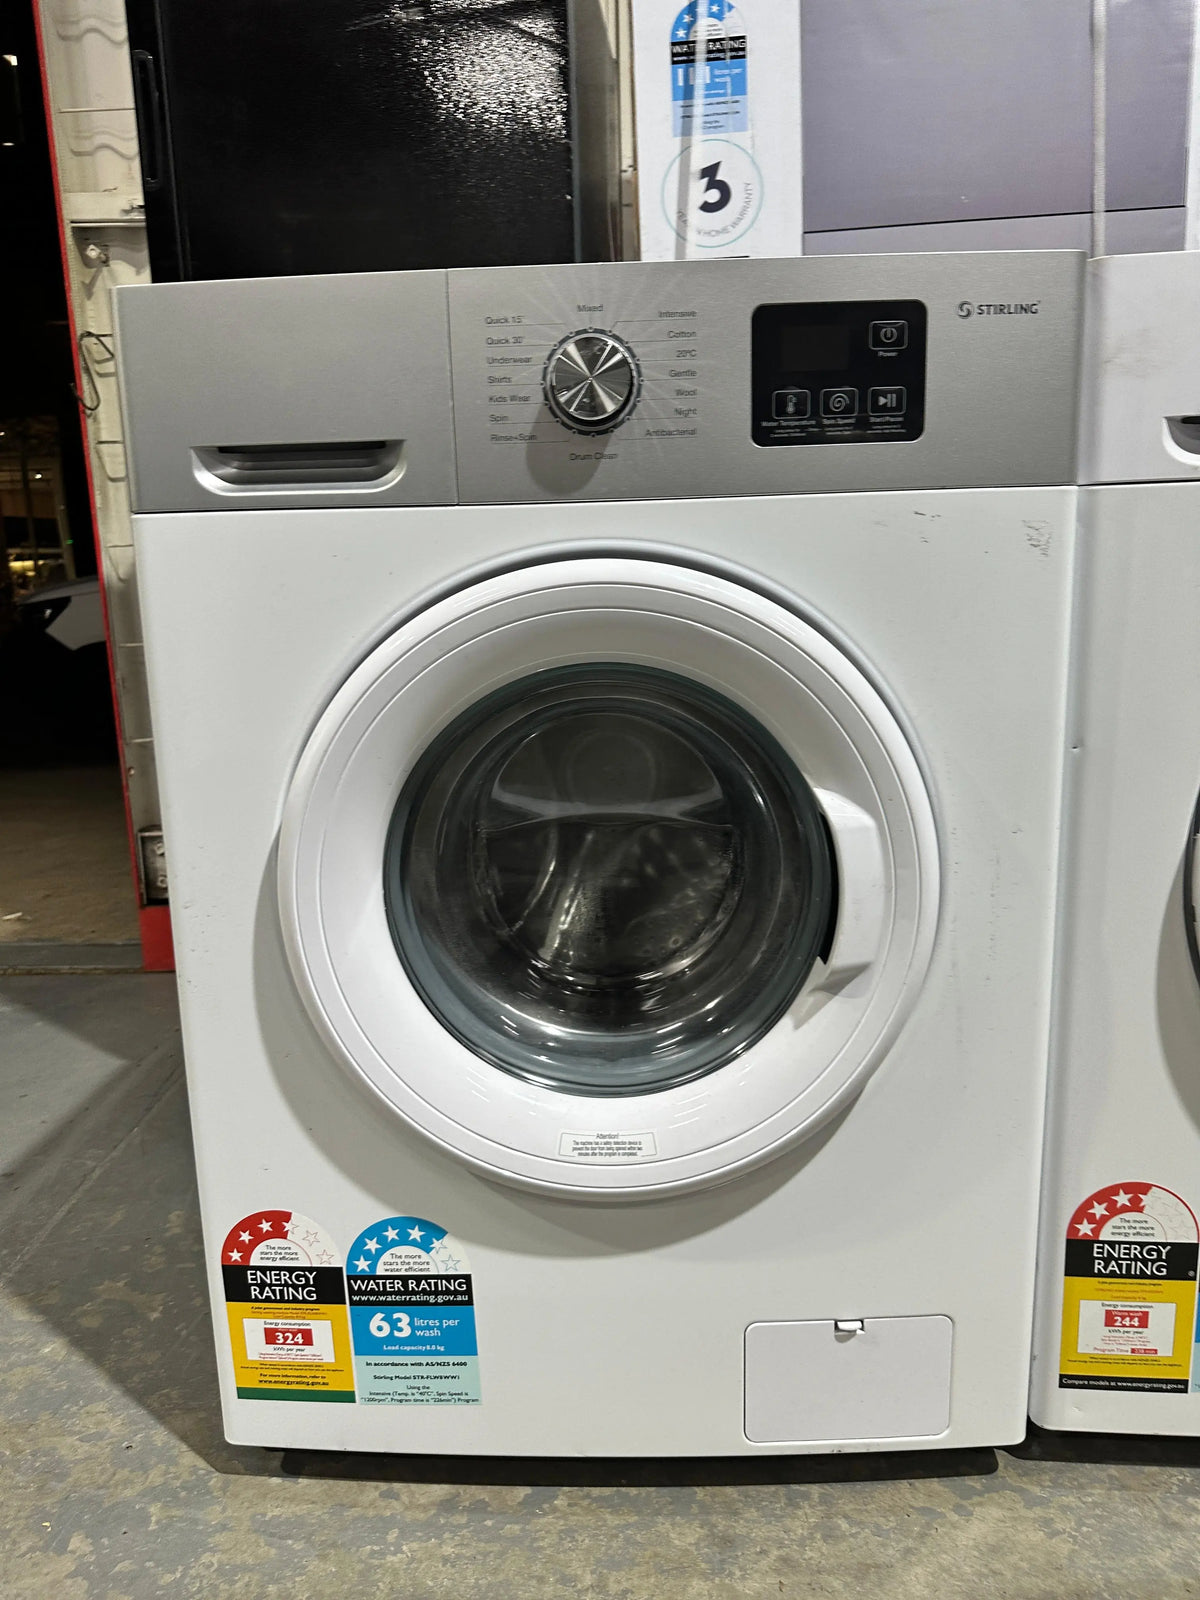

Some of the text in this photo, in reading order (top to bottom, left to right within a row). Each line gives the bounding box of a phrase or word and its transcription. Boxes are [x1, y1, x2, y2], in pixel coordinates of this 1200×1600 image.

[698, 160, 731, 213] 3
[577, 304, 604, 312] Mixed
[976, 303, 1039, 315] STIRLING
[486, 316, 510, 324] Quick
[667, 330, 697, 338] Cotton
[486, 336, 510, 345] Quick
[486, 356, 532, 364] Underwear
[670, 370, 698, 378] Gentle
[488, 376, 512, 384] Shirts
[675, 388, 698, 396] Wool
[674, 408, 698, 418] Night
[489, 414, 509, 423] Spin
[646, 428, 697, 437] Antibacterial
[570, 452, 618, 461] Drum Clean
[1093, 1243, 1171, 1259] ENERGY
[1094, 1260, 1168, 1276] RATING
[247, 1270, 317, 1284] ENERGY
[351, 1279, 467, 1291] WATER RATING
[250, 1286, 317, 1300] RATING
[352, 1293, 468, 1302] www.waterrating.gov.au
[369, 1312, 412, 1338] 63
[414, 1318, 460, 1328] litres per
[1114, 1317, 1139, 1326] 244
[415, 1328, 441, 1336] wash
[275, 1332, 304, 1344] 324
